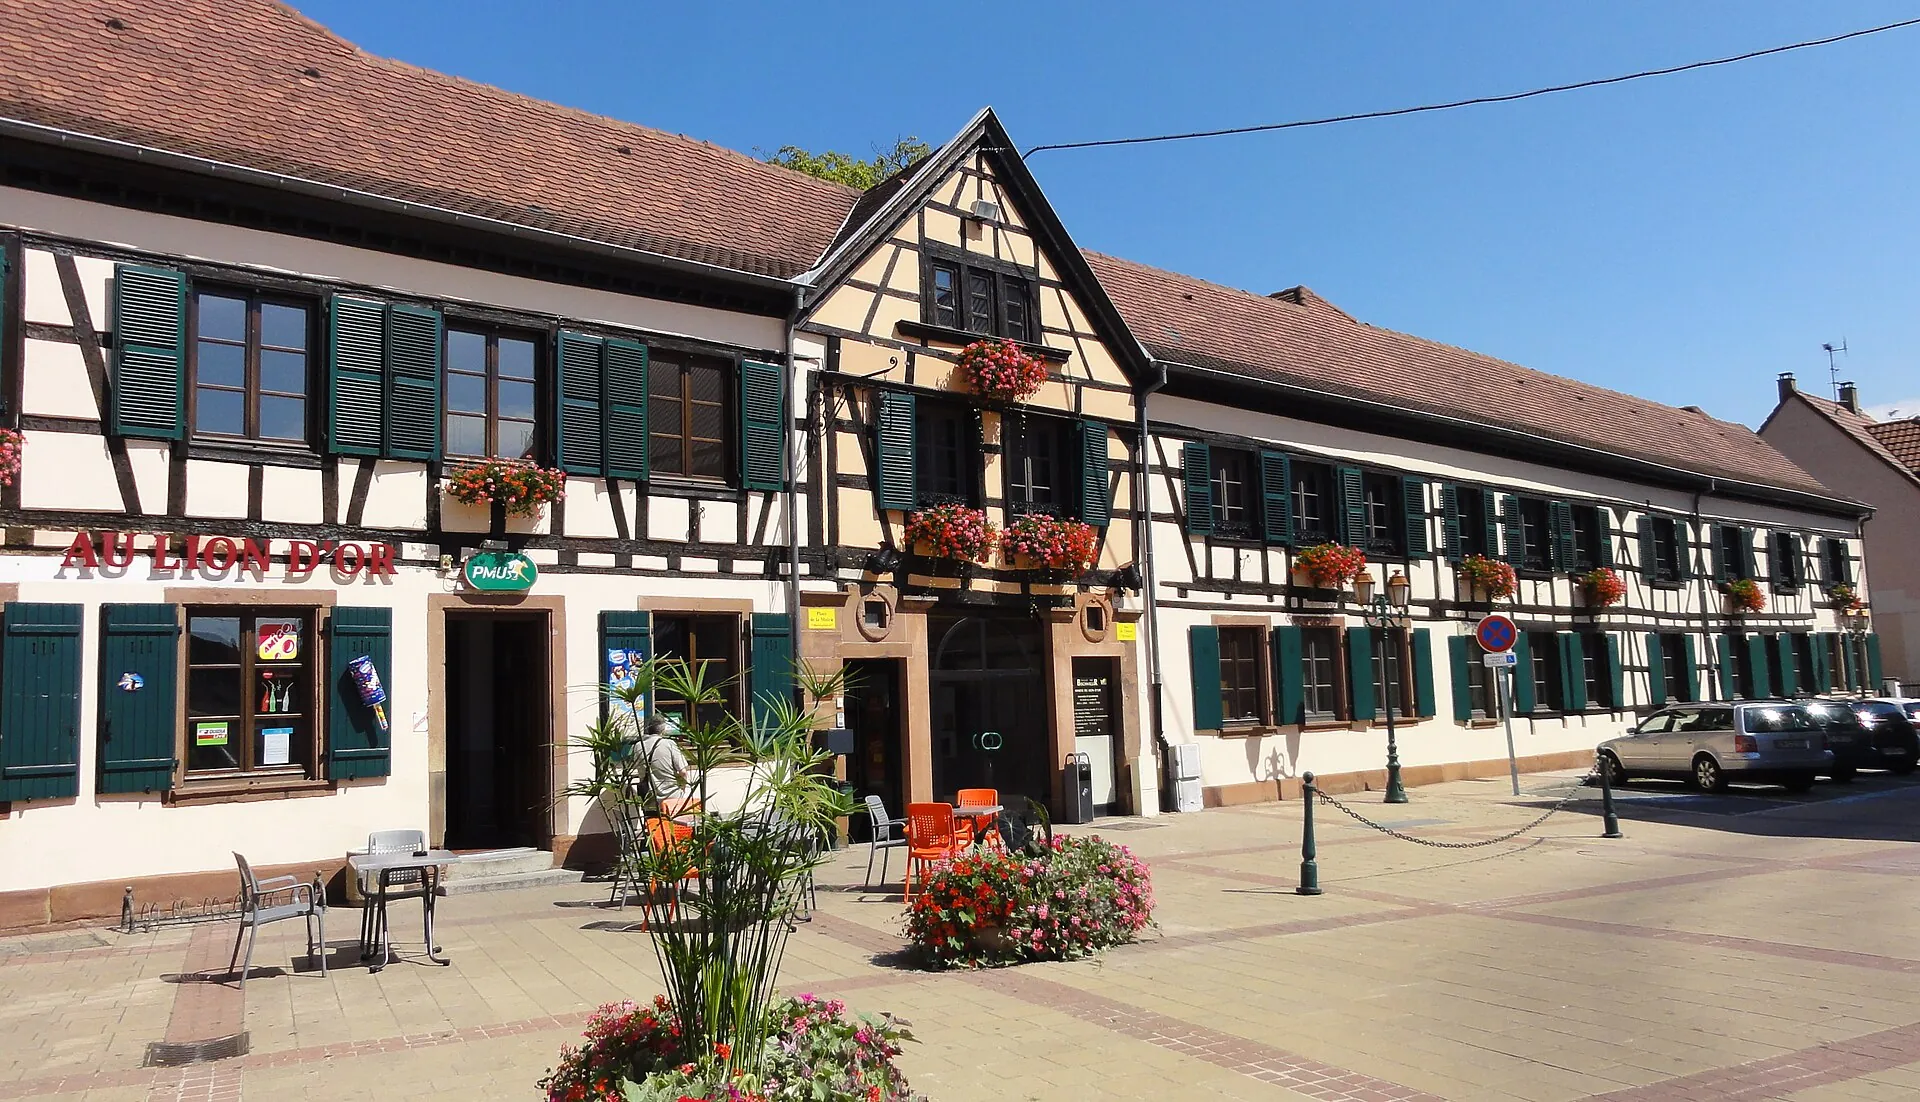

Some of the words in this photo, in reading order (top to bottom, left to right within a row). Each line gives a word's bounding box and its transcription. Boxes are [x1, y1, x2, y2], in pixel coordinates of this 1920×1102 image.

[60, 531, 140, 568] AU
[153, 534, 272, 572] LION
[287, 540, 399, 575] D'OR
[472, 566, 507, 579] PMU
